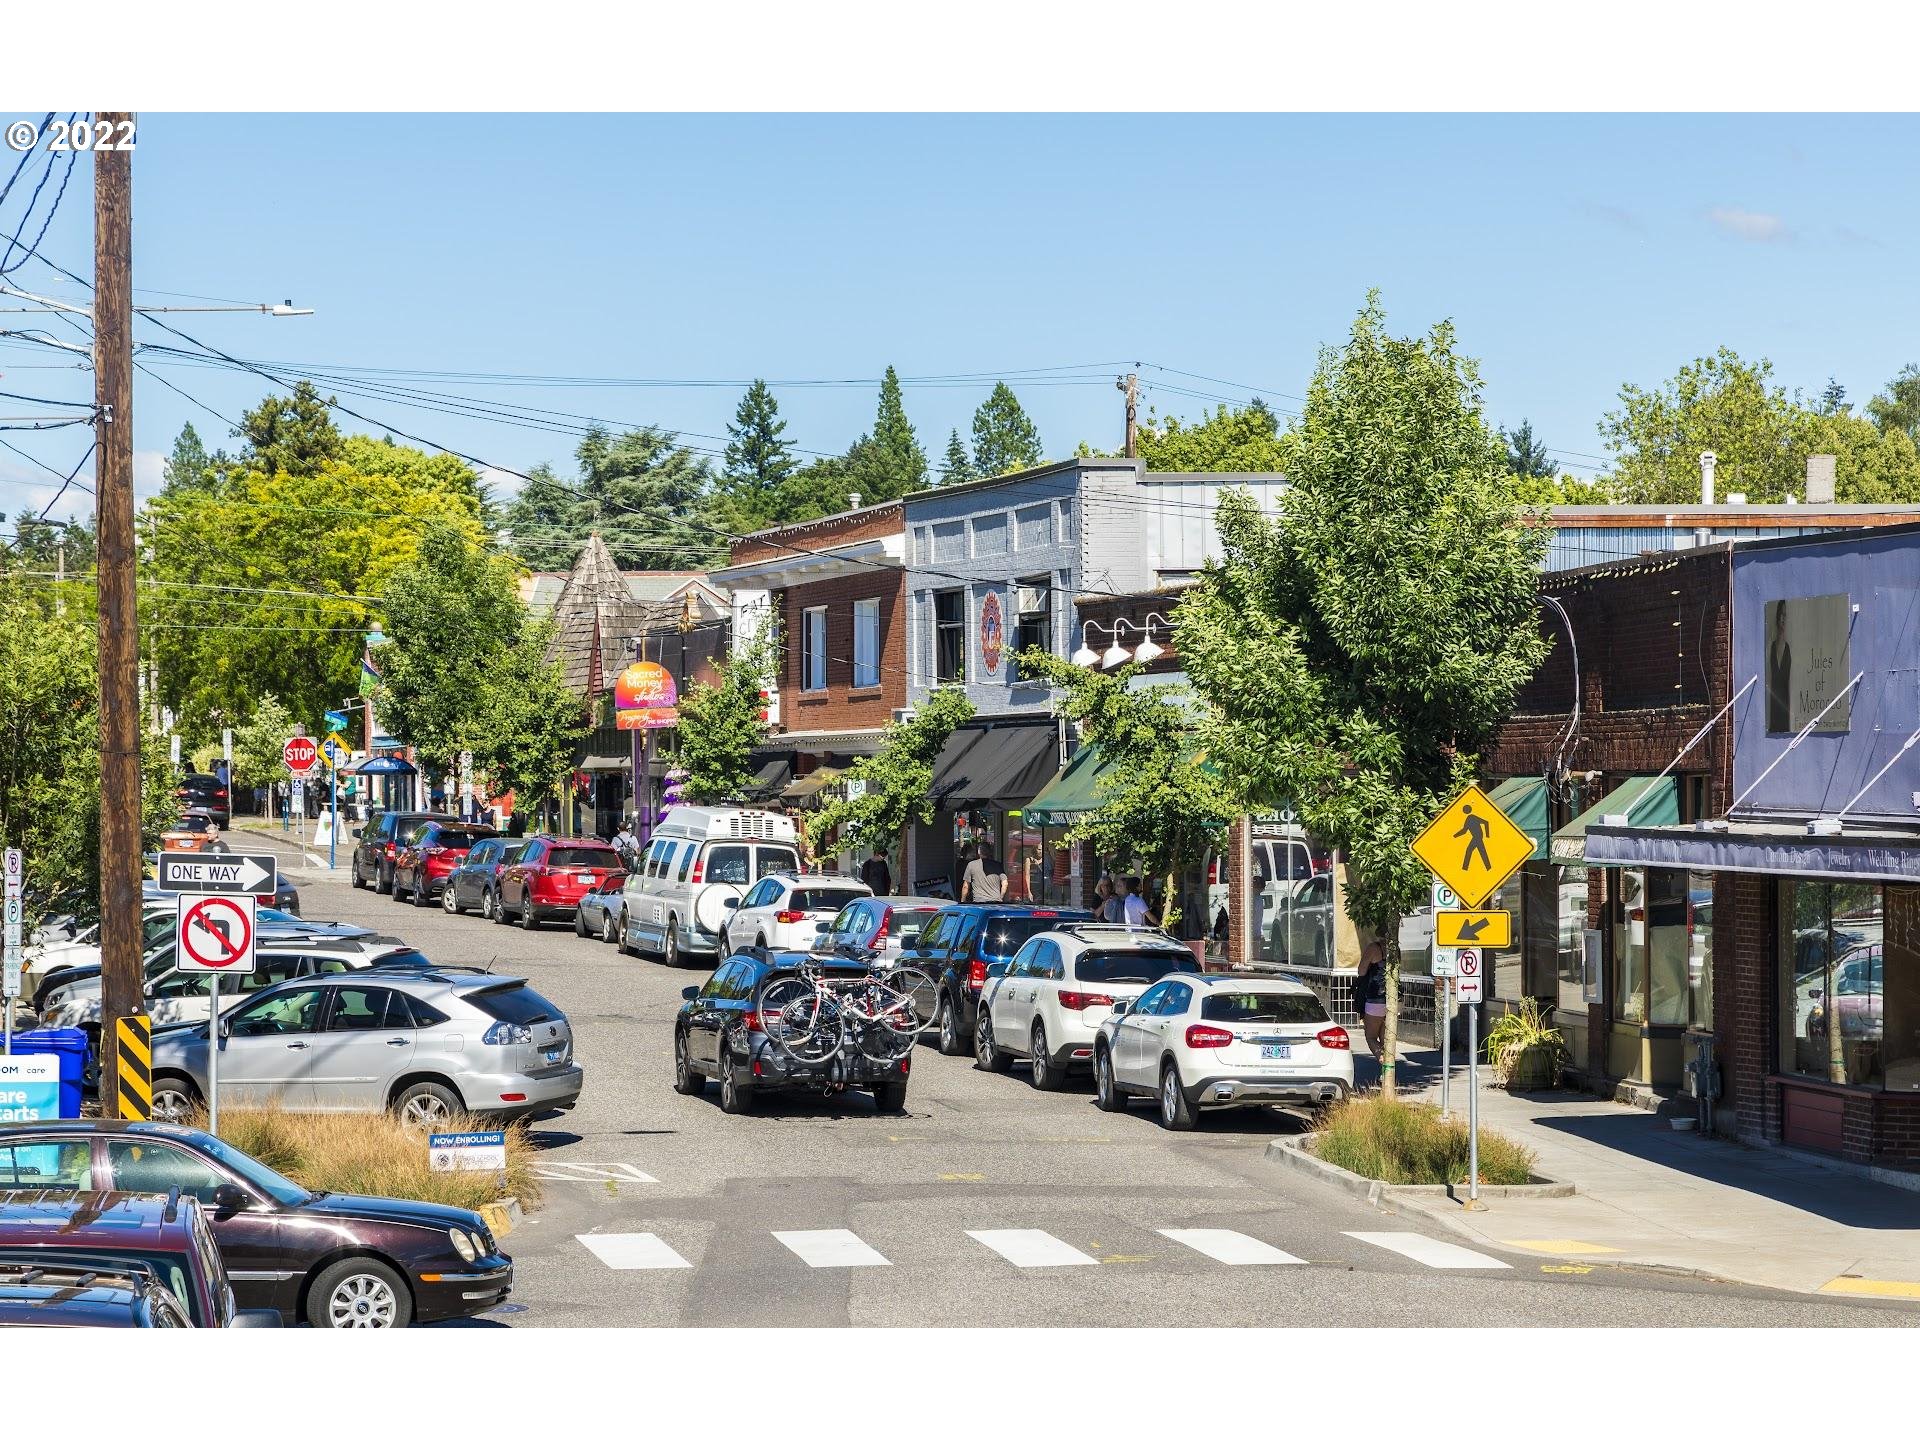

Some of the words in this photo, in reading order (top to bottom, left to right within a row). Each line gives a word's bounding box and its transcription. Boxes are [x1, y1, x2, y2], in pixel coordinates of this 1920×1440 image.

[740, 594, 766, 618] FAT
[1807, 648, 1833, 674] Jules
[625, 668, 663, 679] Sacred
[1815, 670, 1826, 692] of
[627, 679, 662, 690] Money
[286, 748, 315, 761] STOP
[1827, 848, 1851, 869] Jewelry
[1867, 849, 1900, 871] Wedding
[171, 864, 203, 880] ONE
[208, 866, 240, 881] WAY
[0, 1091, 27, 1104] are
[434, 1137, 454, 1145] NOW
[455, 1135, 500, 1144] ENROLLING!
